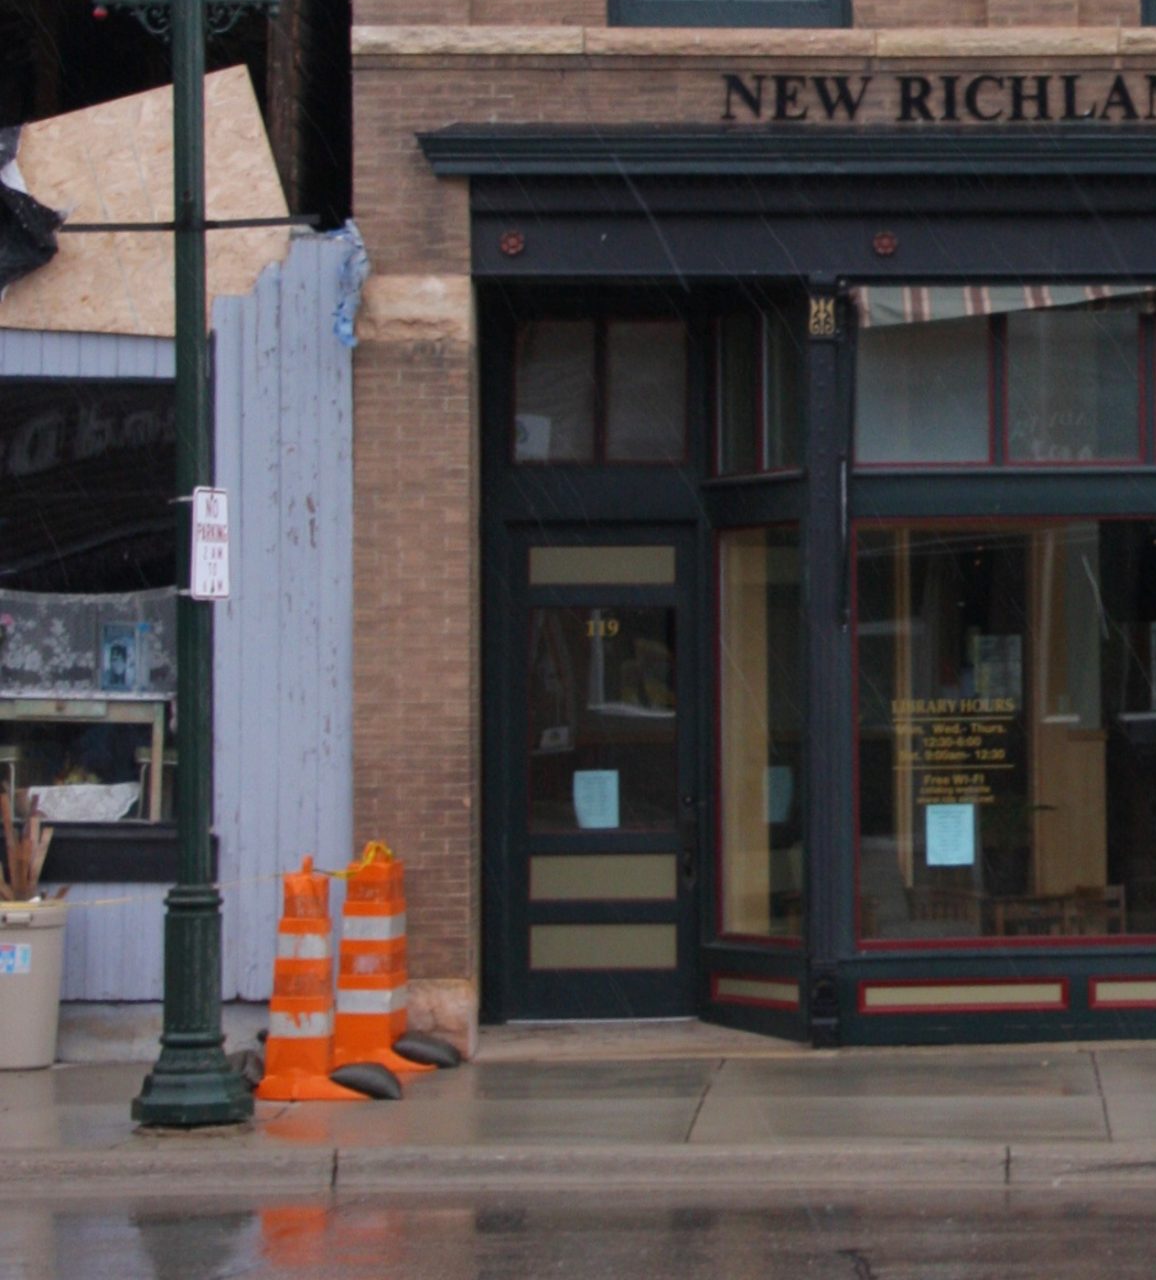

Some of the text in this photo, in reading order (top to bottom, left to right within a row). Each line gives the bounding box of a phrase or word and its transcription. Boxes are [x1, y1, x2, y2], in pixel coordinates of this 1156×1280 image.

[721, 74, 872, 120] NEW
[205, 498, 219, 519] NO
[197, 523, 229, 542] PARKING
[208, 562, 217, 576] TO
[586, 619, 619, 637] 119
[891, 697, 1016, 713] LIBRARY HOURS
[923, 774, 950, 785] Free
